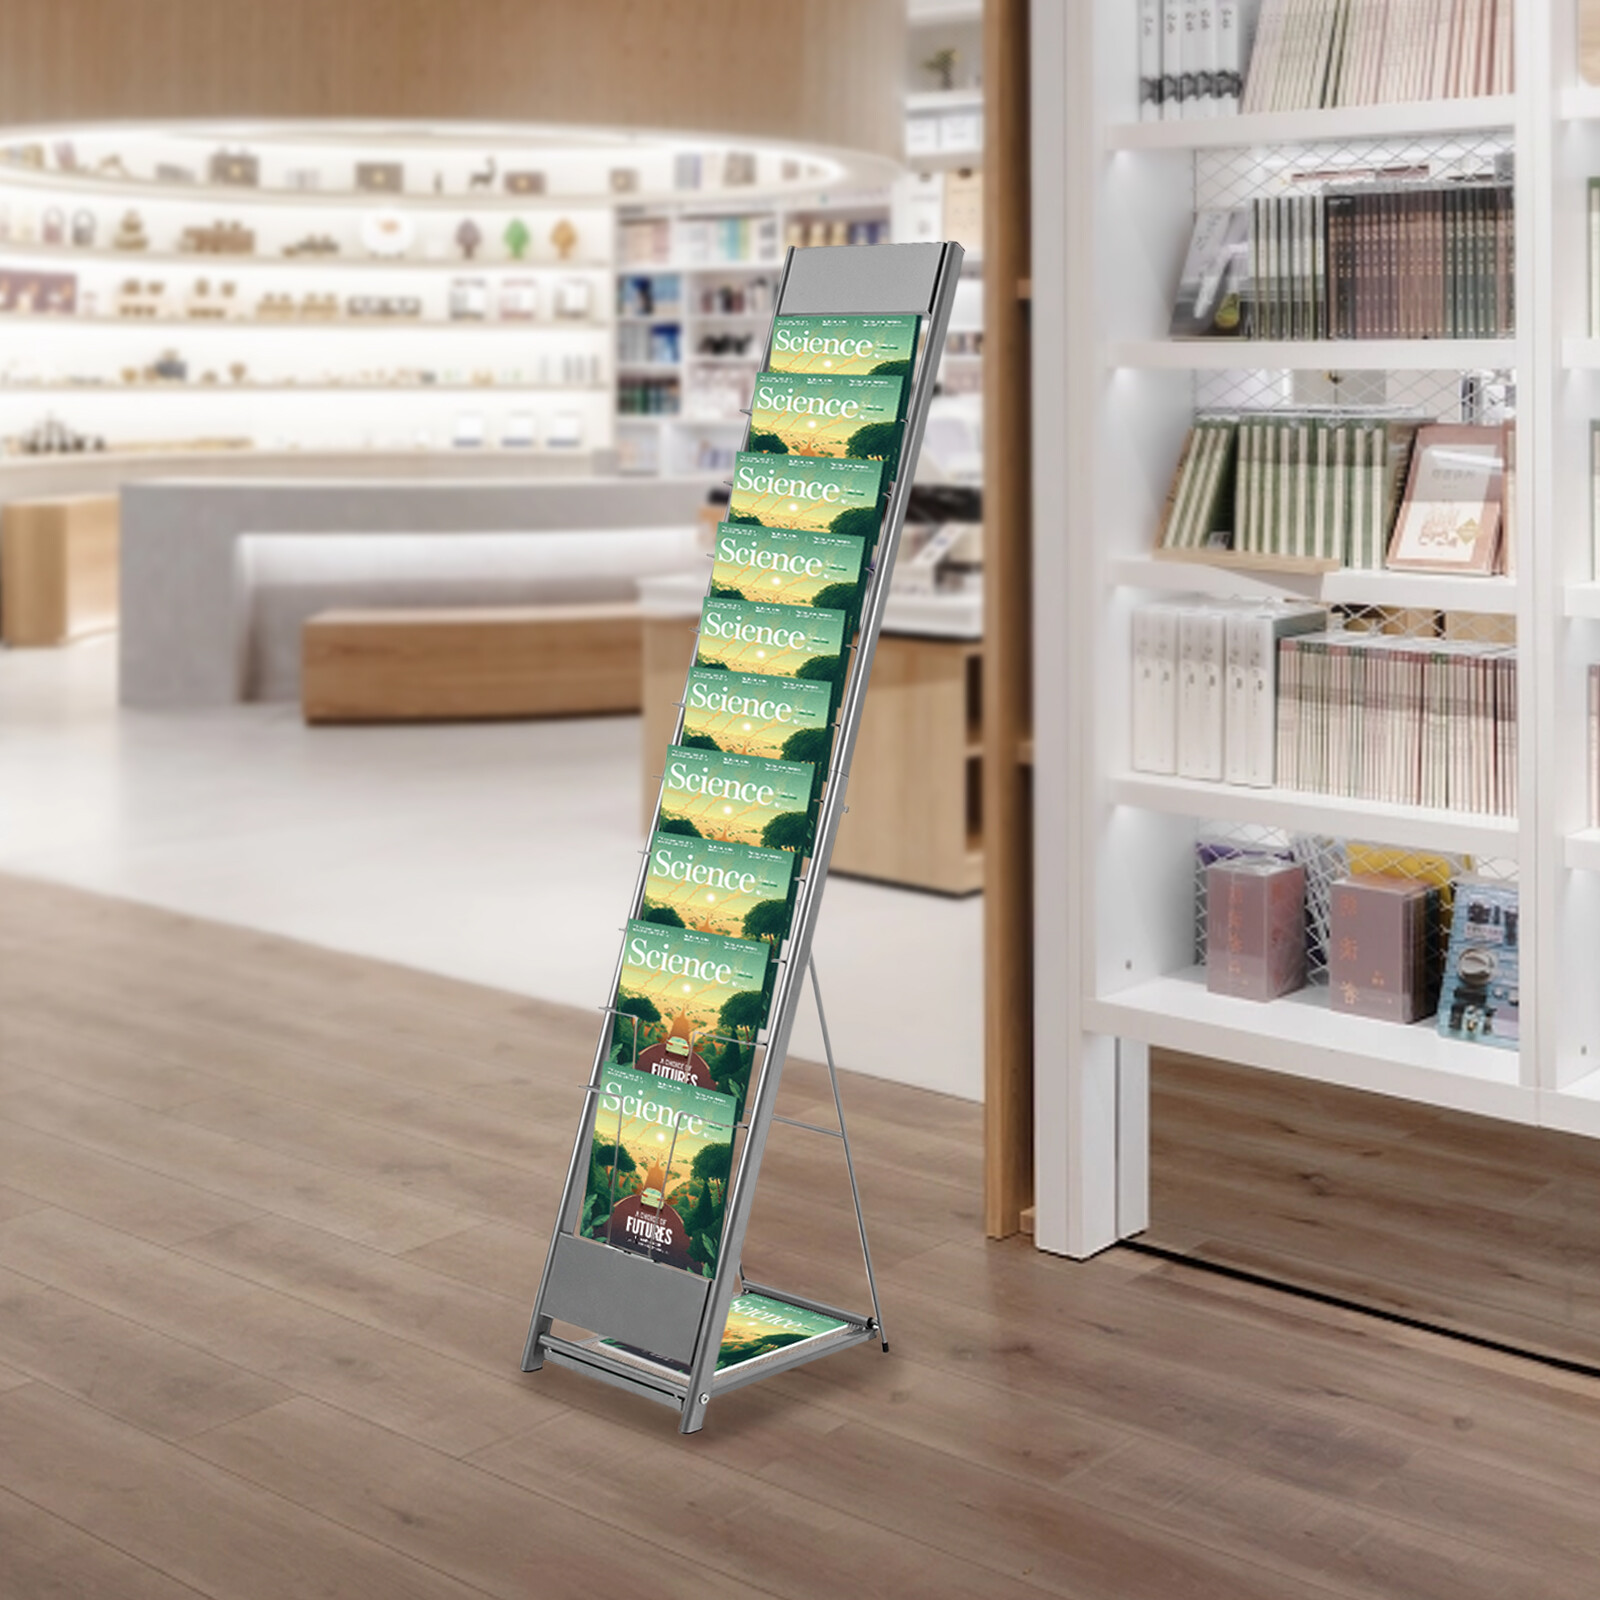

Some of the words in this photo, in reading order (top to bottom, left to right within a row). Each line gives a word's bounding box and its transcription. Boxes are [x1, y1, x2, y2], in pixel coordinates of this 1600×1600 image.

[775, 329, 873, 358] Science
[756, 386, 859, 419] Science
[736, 466, 840, 503] Science
[718, 537, 823, 577] Science
[704, 611, 806, 650] Science
[690, 682, 792, 723] Science
[667, 762, 774, 806] Science
[653, 849, 755, 893] Science
[628, 937, 731, 984] Science
[602, 1081, 703, 1135] Science
[626, 1215, 673, 1245] FUTURES
